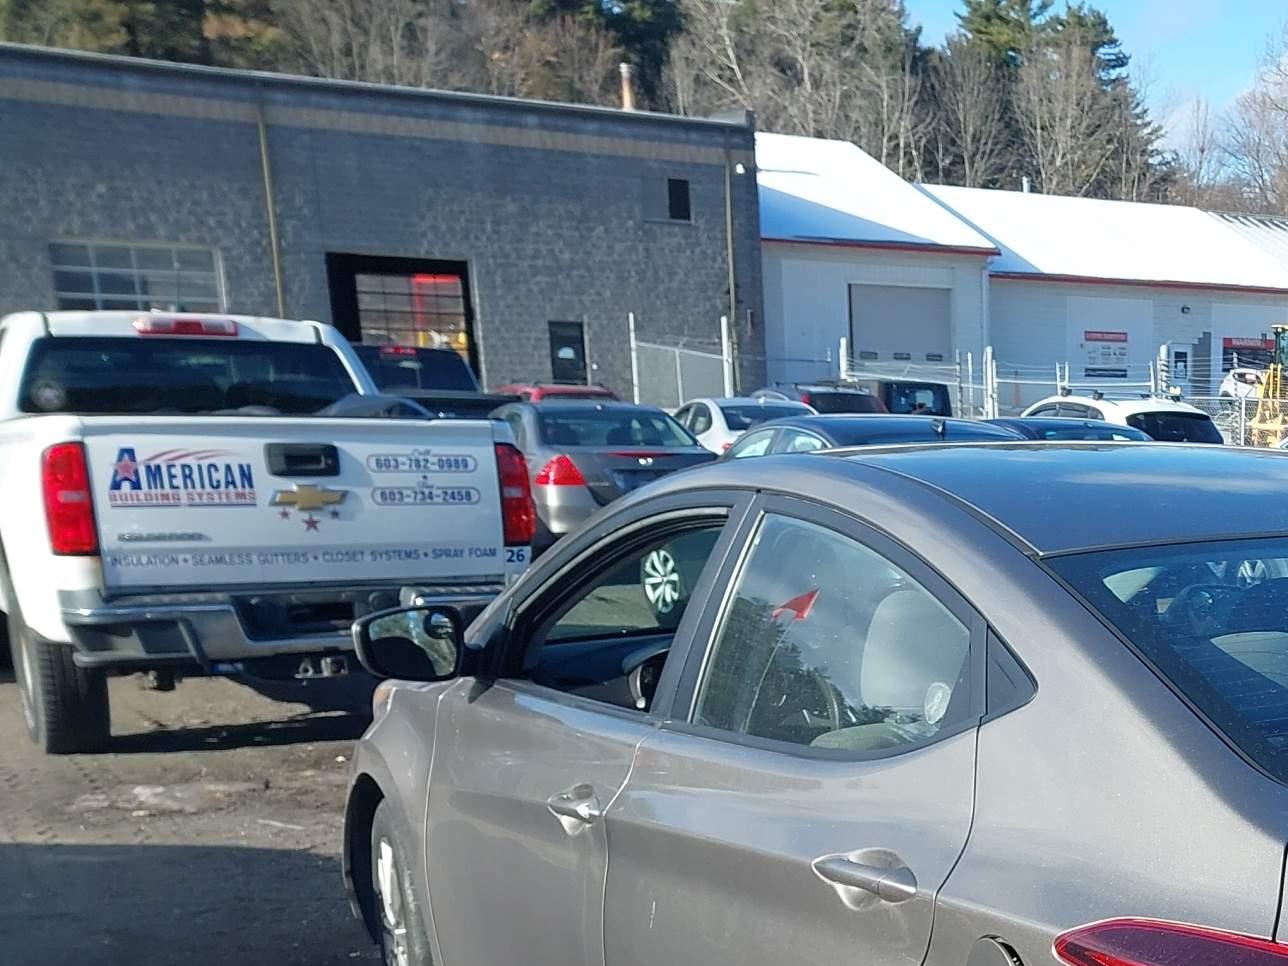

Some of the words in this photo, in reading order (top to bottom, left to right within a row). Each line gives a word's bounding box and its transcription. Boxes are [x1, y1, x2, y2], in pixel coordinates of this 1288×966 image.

[110, 447, 254, 490] AMERICAN
[109, 491, 181, 503] BUILDING
[185, 490, 257, 502] SYSTEMS
[112, 555, 179, 568] INSULATION
[192, 552, 253, 566] SEAMLESS
[257, 551, 309, 565] GUTTERS
[322, 551, 364, 563] CLOSET
[371, 549, 420, 562] SYSTEMS
[432, 548, 464, 560] SPRAY
[469, 547, 497, 558] FOAM
[506, 549, 525, 562] 26
